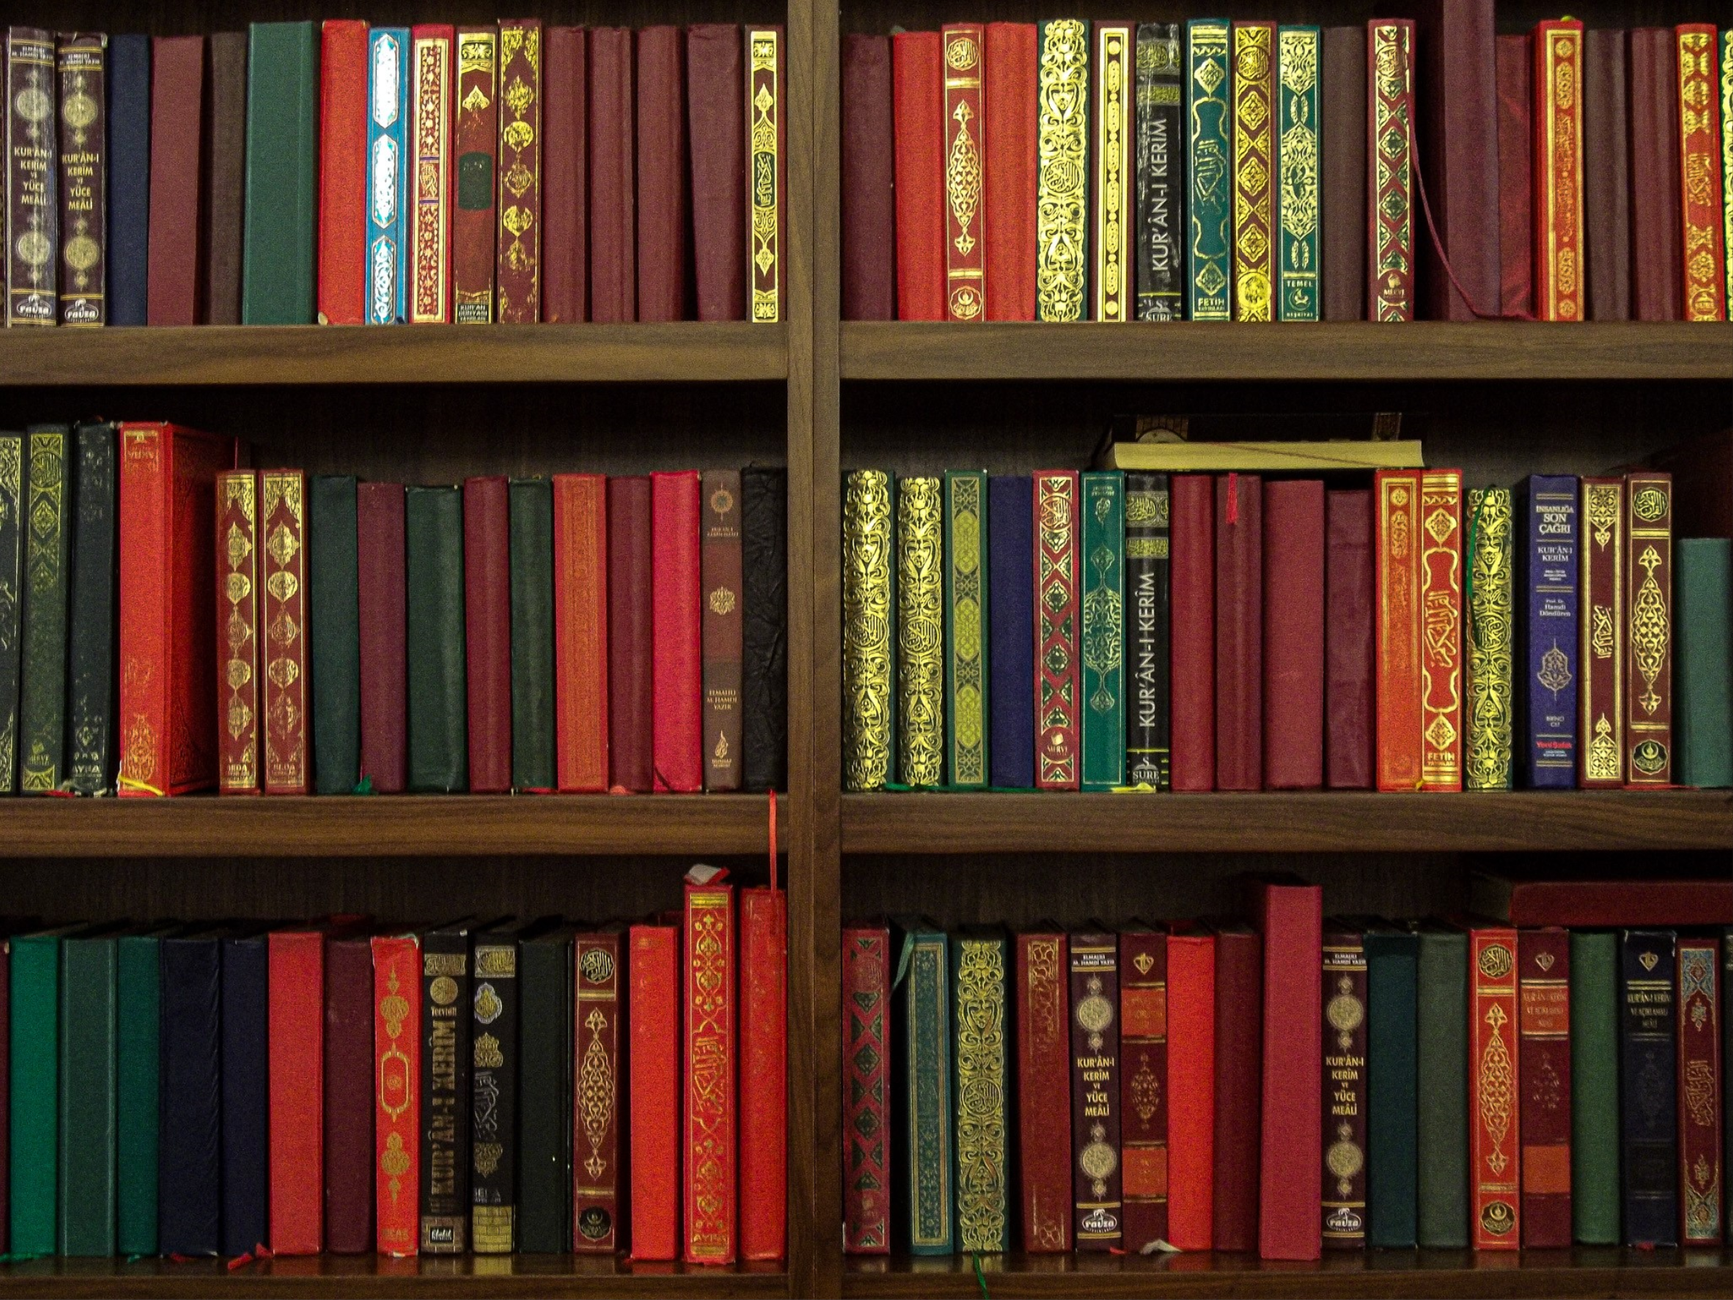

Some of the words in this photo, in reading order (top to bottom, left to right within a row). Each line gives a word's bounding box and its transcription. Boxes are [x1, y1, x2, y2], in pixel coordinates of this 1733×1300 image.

[23, 179, 45, 193] YÜCE
[69, 184, 92, 198] YÜCE
[1147, 183, 1169, 271] KUR'ÂN-I
[1286, 280, 1313, 288] TEMEL
[1197, 297, 1225, 307] FETİH
[1543, 513, 1568, 523] SON
[1538, 522, 1571, 536] ÇAĞRI
[1134, 572, 1155, 631] KERÎM
[1134, 639, 1156, 727] KUR'ÂN-I
[1427, 751, 1455, 761] FETİH
[1132, 771, 1160, 780] SURE
[428, 1019, 456, 1091] KERÎM
[1077, 1054, 1115, 1068] KUR'ÂN-I
[1325, 1053, 1364, 1067] KUR'ÂN-I
[1083, 1068, 1110, 1082] KERÎM
[1331, 1067, 1359, 1080] KERÎM
[1086, 1089, 1108, 1103] YÜCE
[1333, 1089, 1356, 1102] YÜCE
